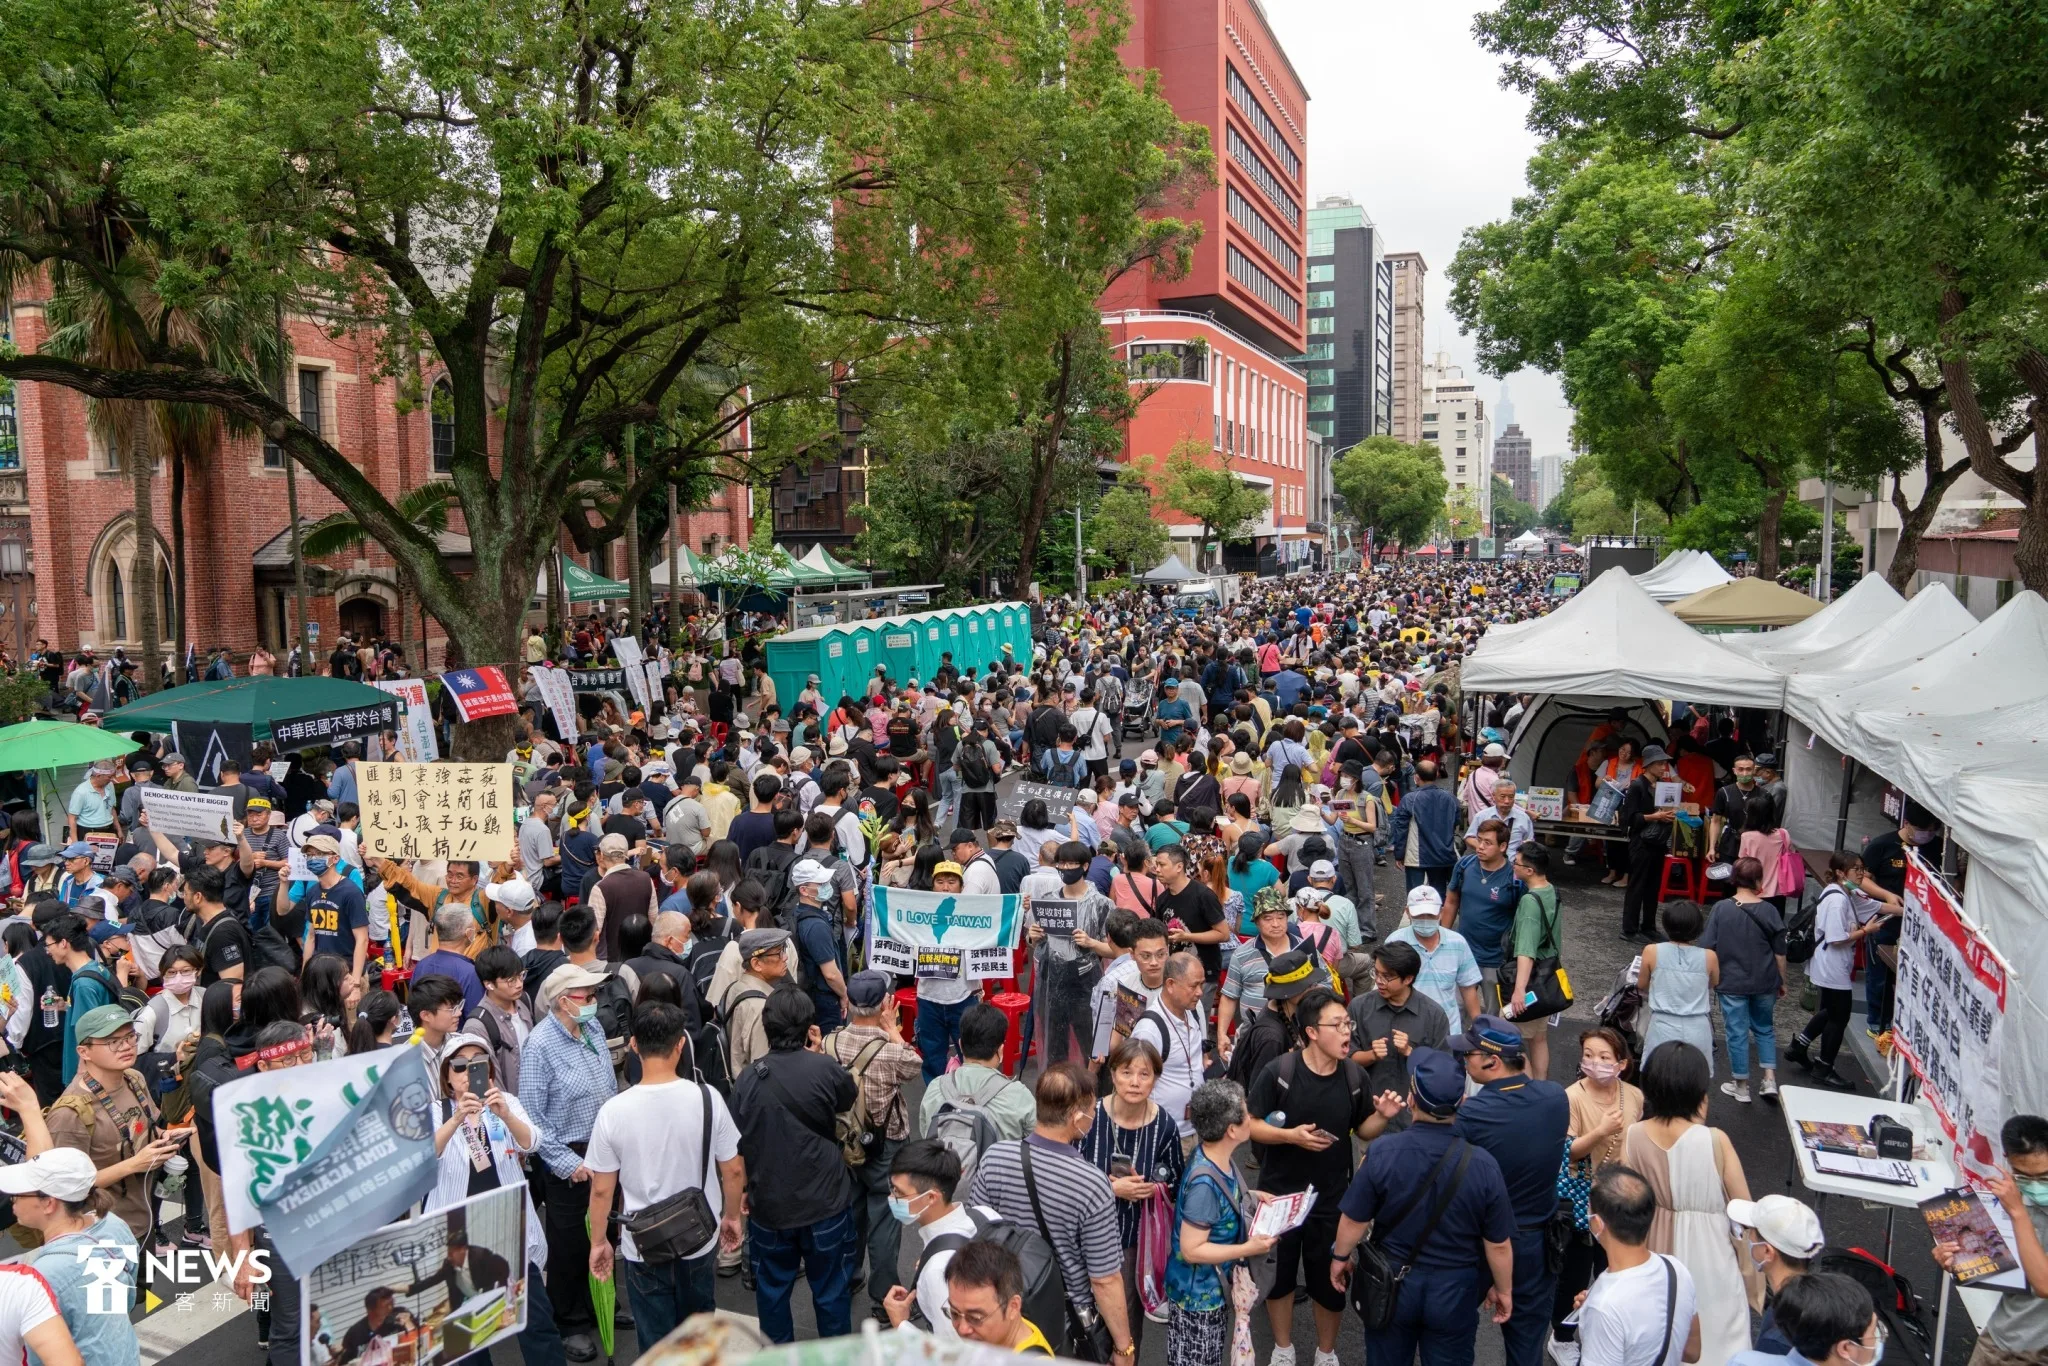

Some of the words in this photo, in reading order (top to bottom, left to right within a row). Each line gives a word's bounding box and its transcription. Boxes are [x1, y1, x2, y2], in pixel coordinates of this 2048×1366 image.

[278, 707, 392, 742] 中華民國不等於台灣
[144, 791, 179, 801] DEMOCRACY
[180, 795, 197, 803] CAN'T
[206, 798, 228, 806] RIGGED
[897, 909, 903, 922] I
[907, 910, 938, 925] LOVE
[946, 914, 992, 929] TAIWAN
[1036, 907, 1072, 918] 沒收討論
[874, 940, 911, 955] 沒有討論
[971, 948, 1007, 958] 沒有討論
[872, 954, 910, 969] 不是民主
[971, 961, 1009, 972] 不是民主
